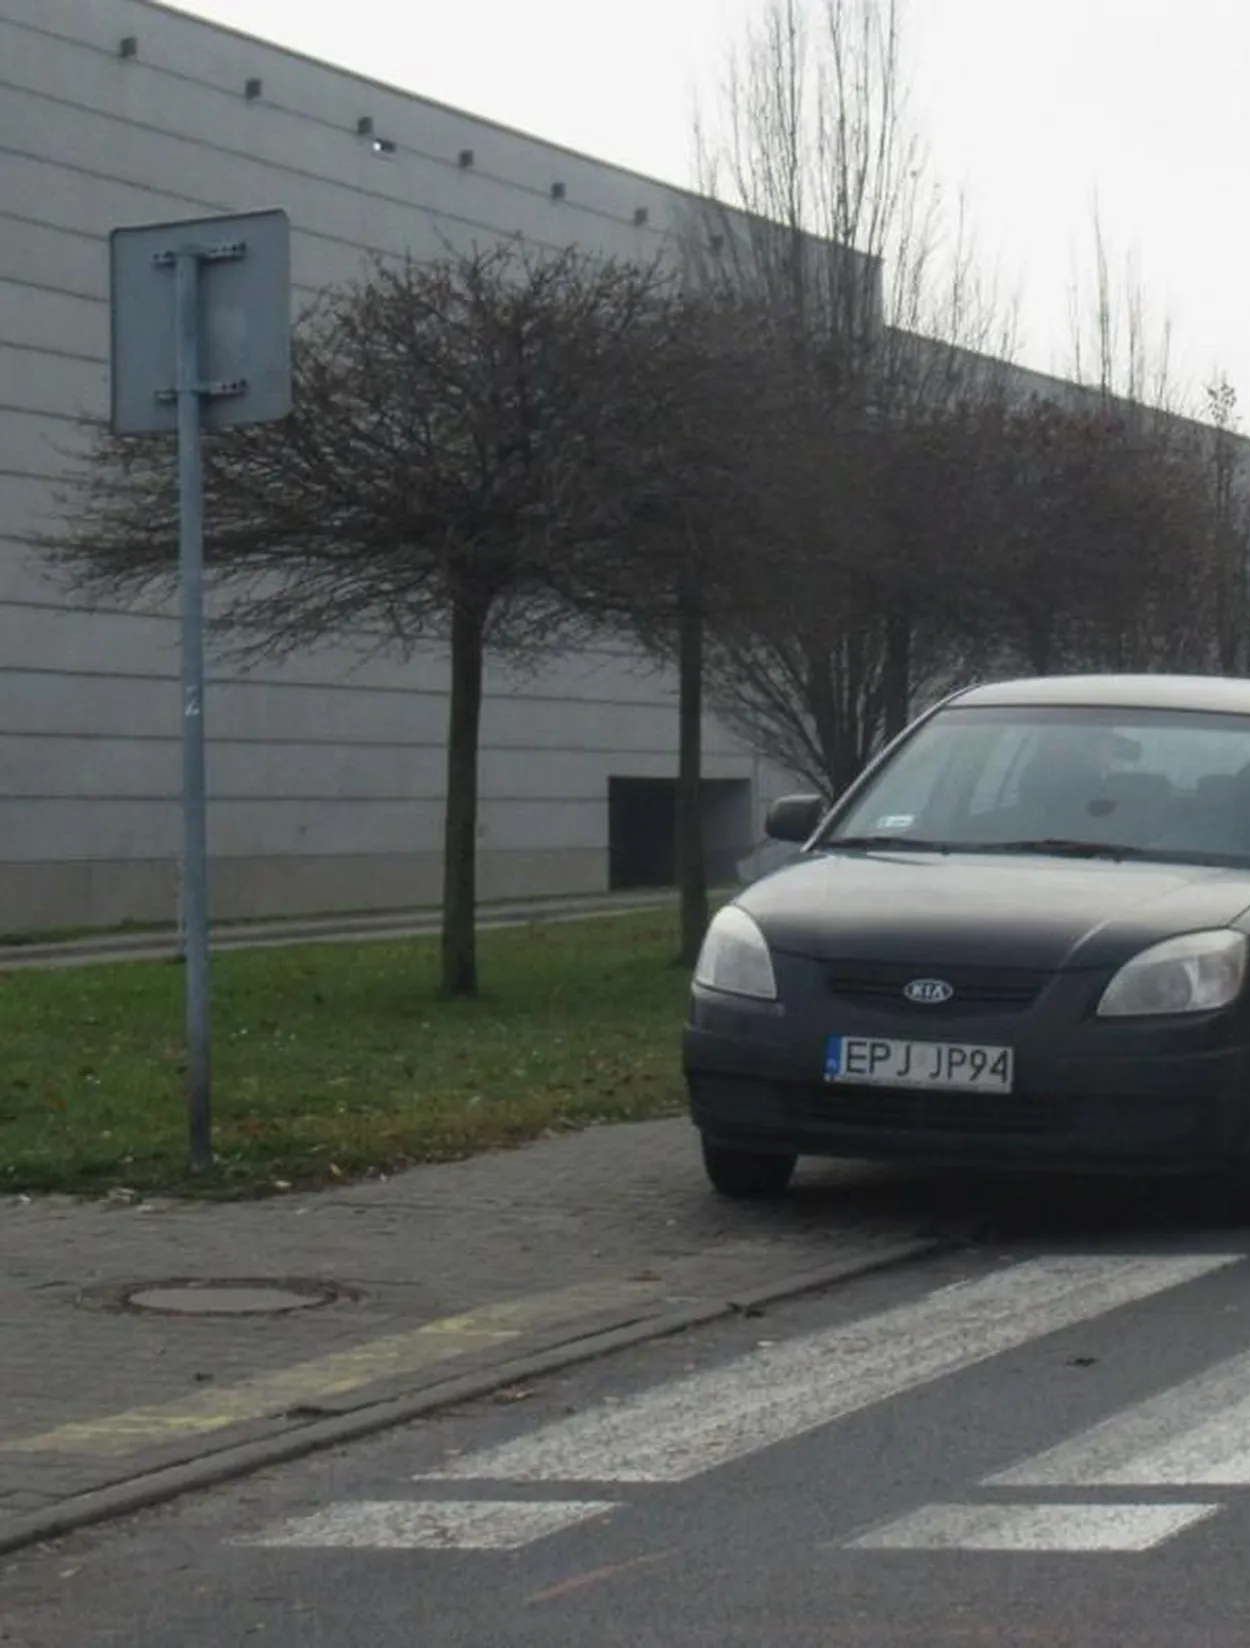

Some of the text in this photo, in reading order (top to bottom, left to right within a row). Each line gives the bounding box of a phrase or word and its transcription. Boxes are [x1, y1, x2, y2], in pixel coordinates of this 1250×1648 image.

[909, 982, 947, 1000] KIA
[846, 1040, 1009, 1084] EPJ JP94
